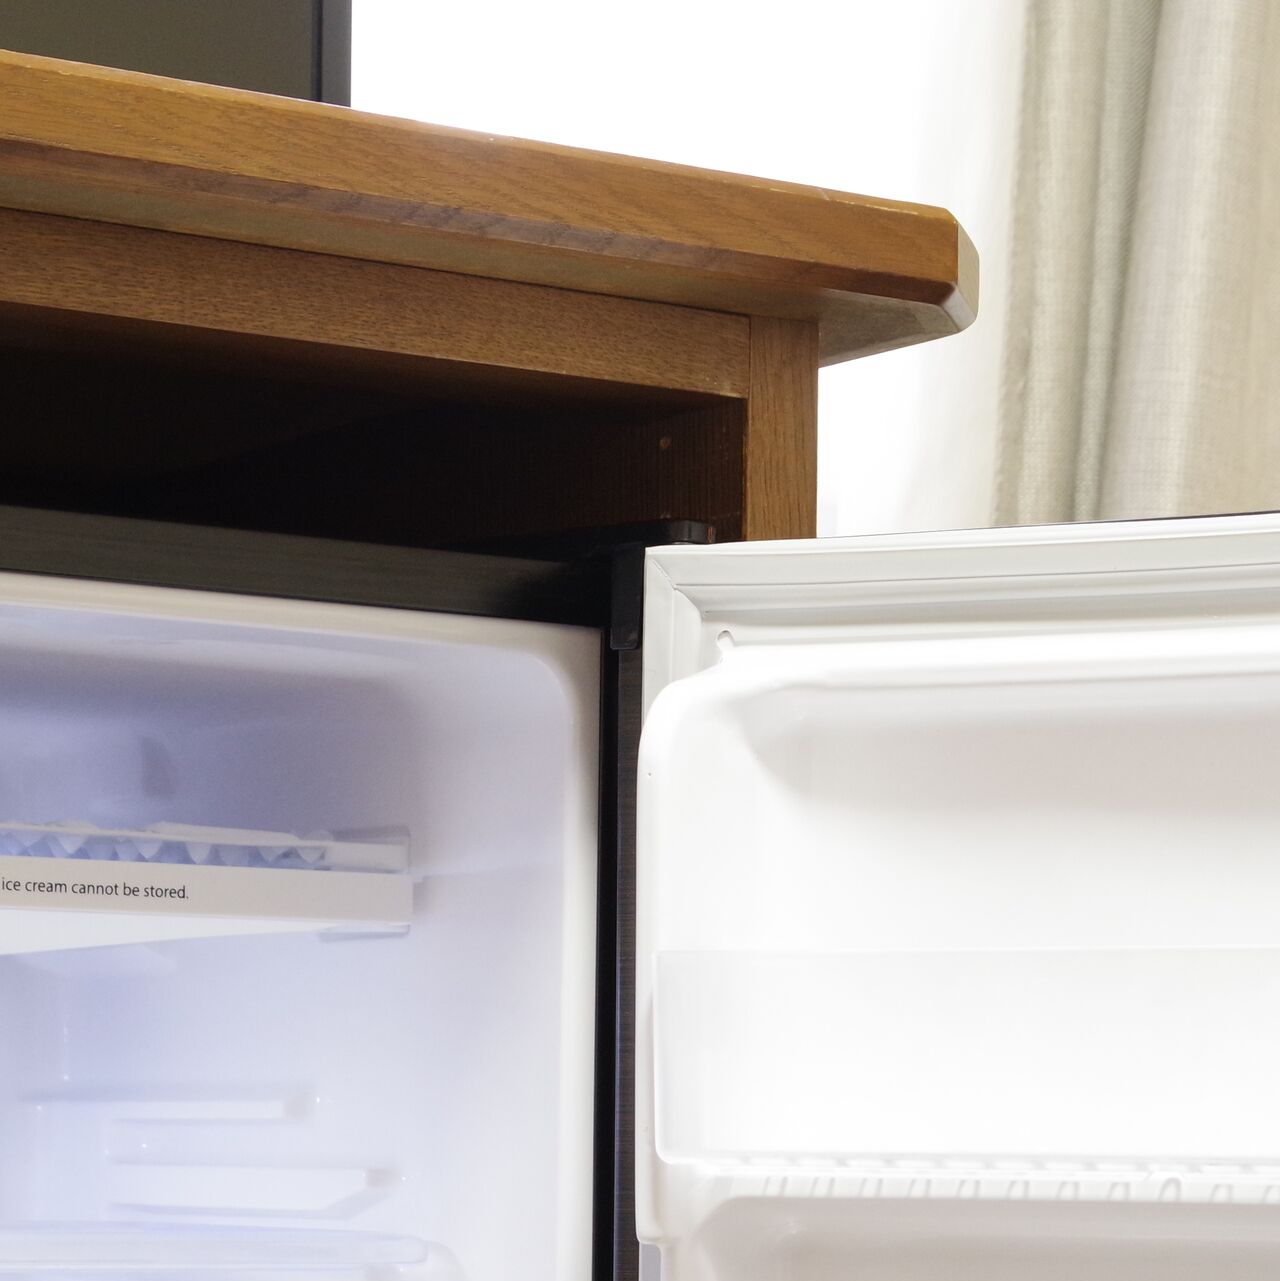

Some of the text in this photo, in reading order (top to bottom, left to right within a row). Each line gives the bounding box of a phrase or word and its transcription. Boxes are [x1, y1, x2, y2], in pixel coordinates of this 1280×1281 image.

[1, 876, 21, 891] ice
[25, 881, 67, 893] cream
[71, 882, 119, 896] cannot
[123, 882, 140, 897] be
[144, 884, 189, 899] stored.
